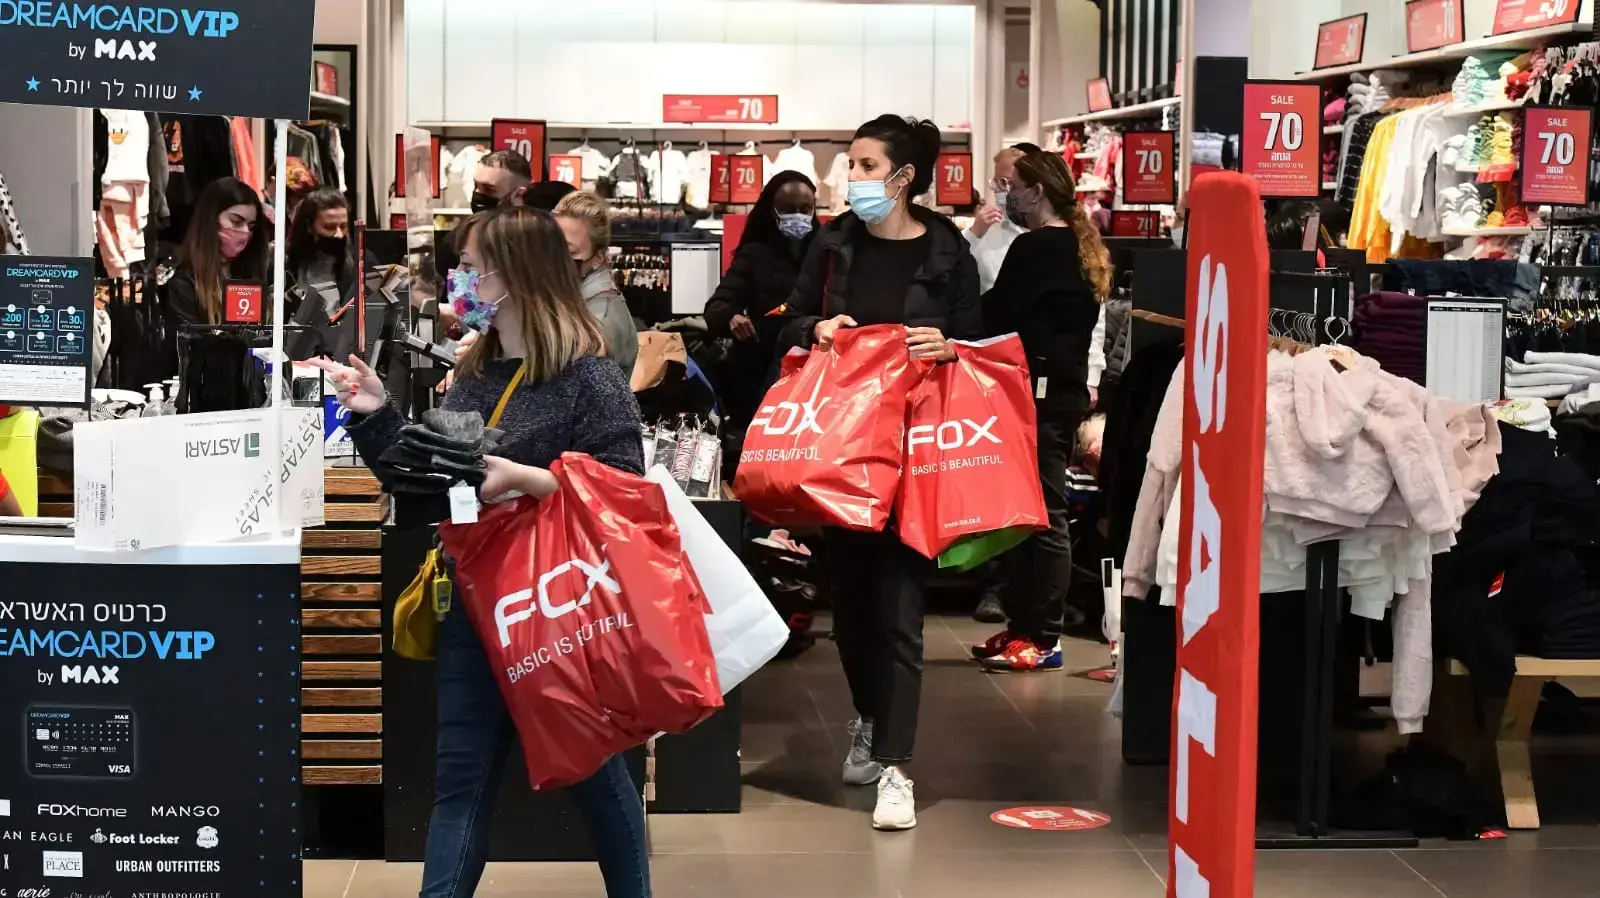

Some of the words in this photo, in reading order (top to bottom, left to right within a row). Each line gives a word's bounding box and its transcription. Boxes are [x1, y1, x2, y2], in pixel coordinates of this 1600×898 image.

[0, 1, 179, 34] DREAMCARD
[181, 9, 240, 38] VIP
[69, 42, 86, 60] by
[95, 38, 157, 61] MAX
[51, 78, 91, 95] יותר
[101, 78, 125, 101] לך
[135, 83, 178, 101] שווה
[1271, 95, 1294, 105] SALE
[738, 98, 763, 120] 70
[1547, 118, 1568, 127] SALE
[1260, 112, 1303, 151] 70
[1142, 138, 1157, 146] SALE
[1538, 132, 1575, 165] 70
[1136, 150, 1163, 174] 70
[556, 167, 574, 182] 70
[718, 168, 729, 183] 7
[736, 168, 755, 184] 70
[944, 165, 964, 183] 70
[1137, 216, 1153, 231] 70
[7, 268, 61, 278] DREAMCARD
[62, 270, 79, 278] VIP
[5, 313, 21, 323] 200
[40, 314, 50, 323] 12
[69, 315, 80, 325] 30
[747, 396, 832, 436] FOX
[908, 415, 1003, 455] FOX
[185, 437, 241, 459] ASTARI
[740, 450, 755, 463] SIC
[766, 447, 822, 462] BEAUTIFUL
[911, 463, 938, 476] BASIC
[949, 454, 1003, 470] BEAUTIFUL
[240, 412, 322, 536] ASTARGLAS
[0, 601, 85, 621] האשרא
[94, 602, 167, 622] כרטיס
[494, 558, 622, 649] FOX
[0, 628, 147, 659] EAMCARD
[148, 630, 216, 660] VIP
[506, 647, 551, 684] BASIC
[553, 636, 574, 657] IS
[38, 669, 54, 685] by
[61, 664, 120, 684] MAX
[108, 764, 131, 774] VISA
[37, 803, 128, 818] FOXhome
[151, 805, 221, 817] MANGO
[3, 830, 22, 841] AN
[31, 831, 74, 842] EAGLE
[109, 833, 136, 845] Foot
[139, 833, 180, 845] Locker
[46, 860, 81, 872] PLACE
[115, 860, 153, 873] URBAN
[157, 860, 221, 873] OUTFITTERS
[17, 884, 51, 898] aerie
